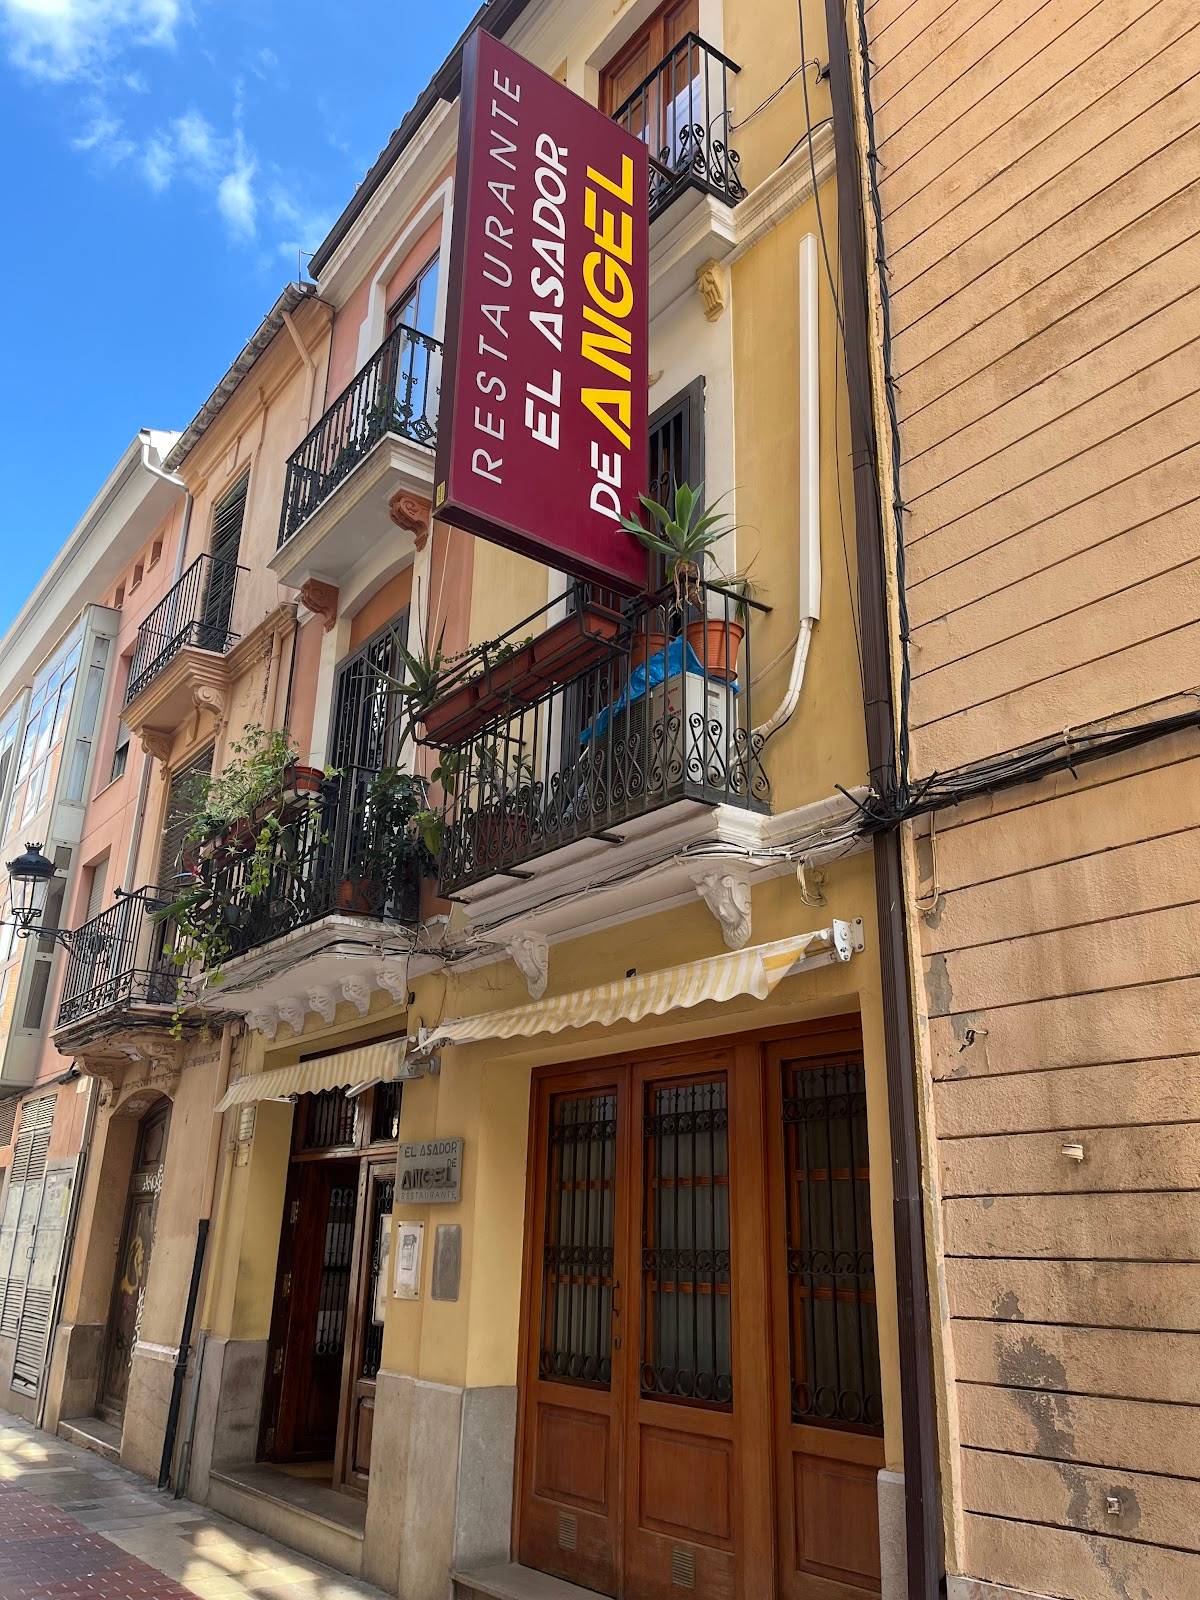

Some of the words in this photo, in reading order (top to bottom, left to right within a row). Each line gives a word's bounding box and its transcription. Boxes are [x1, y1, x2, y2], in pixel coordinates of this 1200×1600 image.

[471, 68, 522, 485] RESTAURANTE
[529, 132, 569, 351] ASADOR
[581, 153, 634, 450] ANGEL
[525, 369, 561, 450] EL
[589, 440, 621, 522] DE
[404, 1147, 416, 1158] EL
[420, 1141, 457, 1157] ASADOR
[447, 1158, 457, 1168] DE
